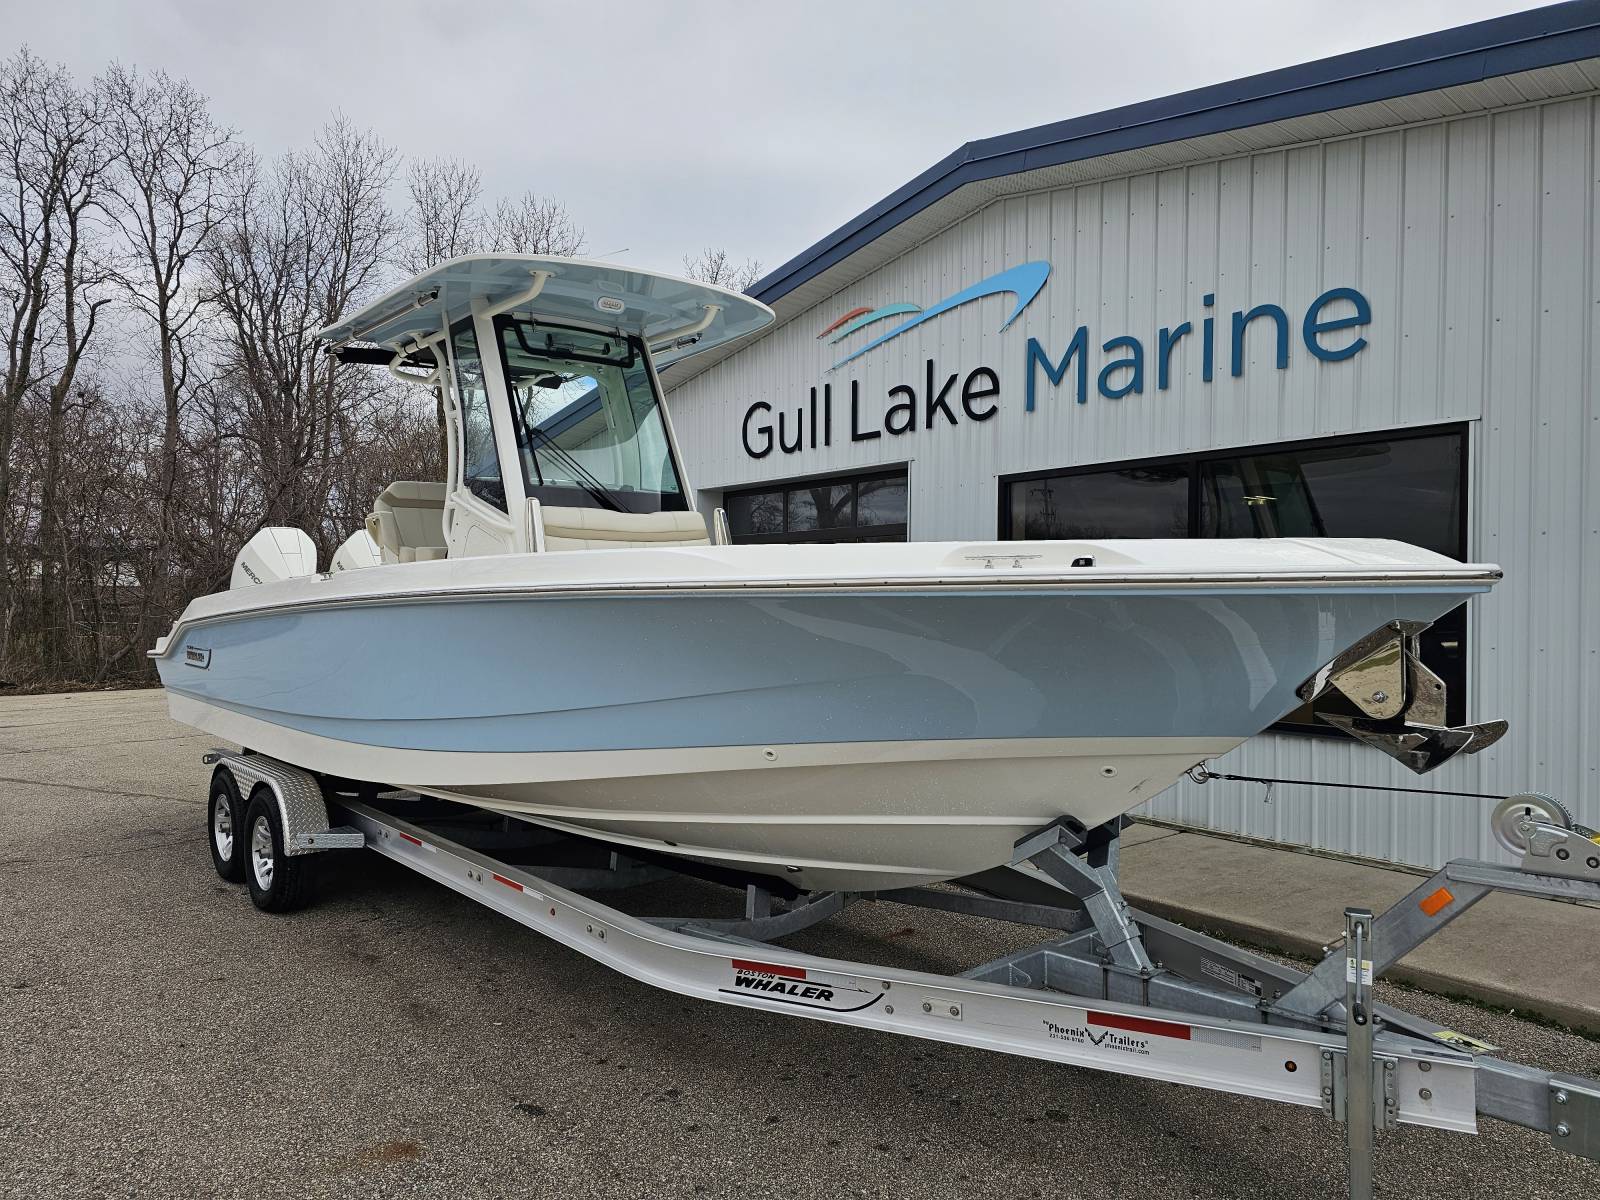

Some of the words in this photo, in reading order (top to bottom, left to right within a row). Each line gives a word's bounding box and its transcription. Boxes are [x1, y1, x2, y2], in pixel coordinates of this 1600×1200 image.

[742, 385, 832, 459] Gull
[850, 358, 1001, 443] Lake
[1025, 286, 1372, 412] Marine
[737, 969, 776, 980] BOSTON
[735, 975, 834, 1002] WHALER
[1048, 1023, 1085, 1038] Phoenix
